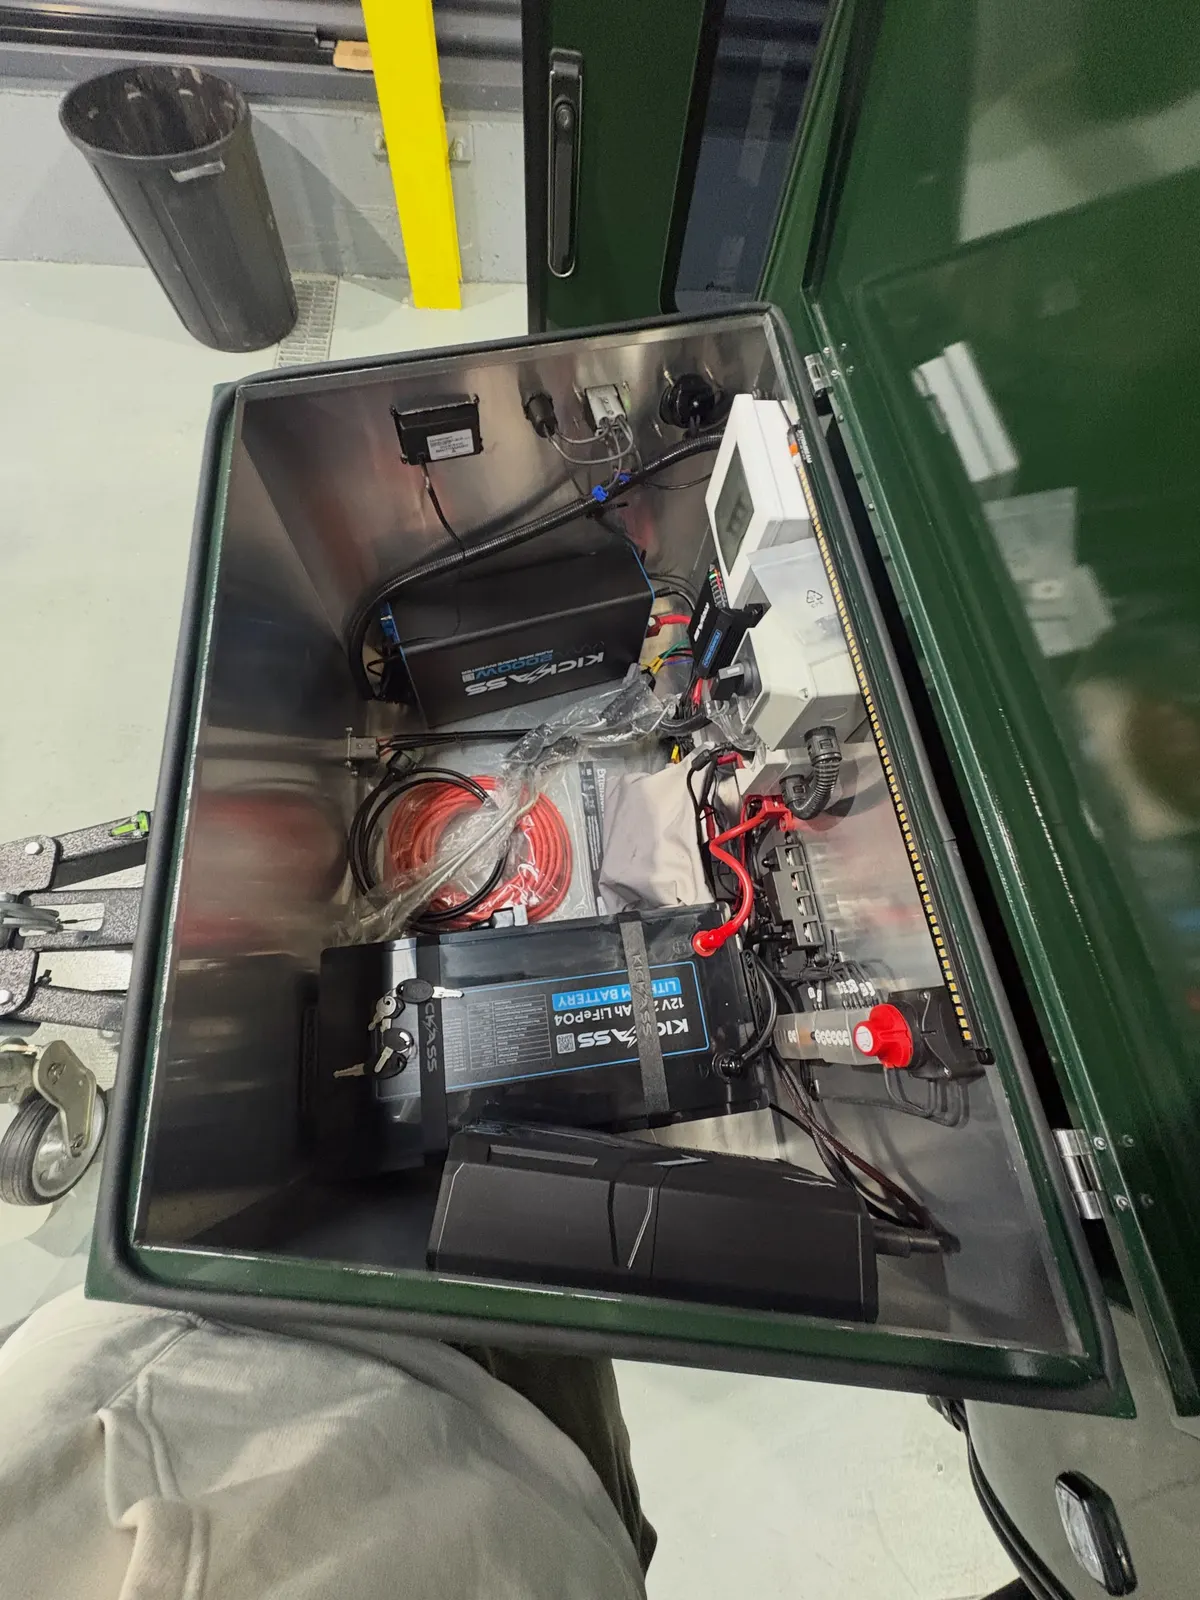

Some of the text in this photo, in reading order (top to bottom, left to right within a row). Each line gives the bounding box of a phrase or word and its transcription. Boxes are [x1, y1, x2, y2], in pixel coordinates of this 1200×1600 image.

[464, 652, 605, 696] KICKASS
[557, 980, 677, 1008] LITHM BATTERY
[661, 997, 685, 1011] 12V
[554, 1006, 613, 1026] LiFePO4
[422, 1002, 440, 1073] CKASS
[577, 1018, 689, 1049] KICASS
